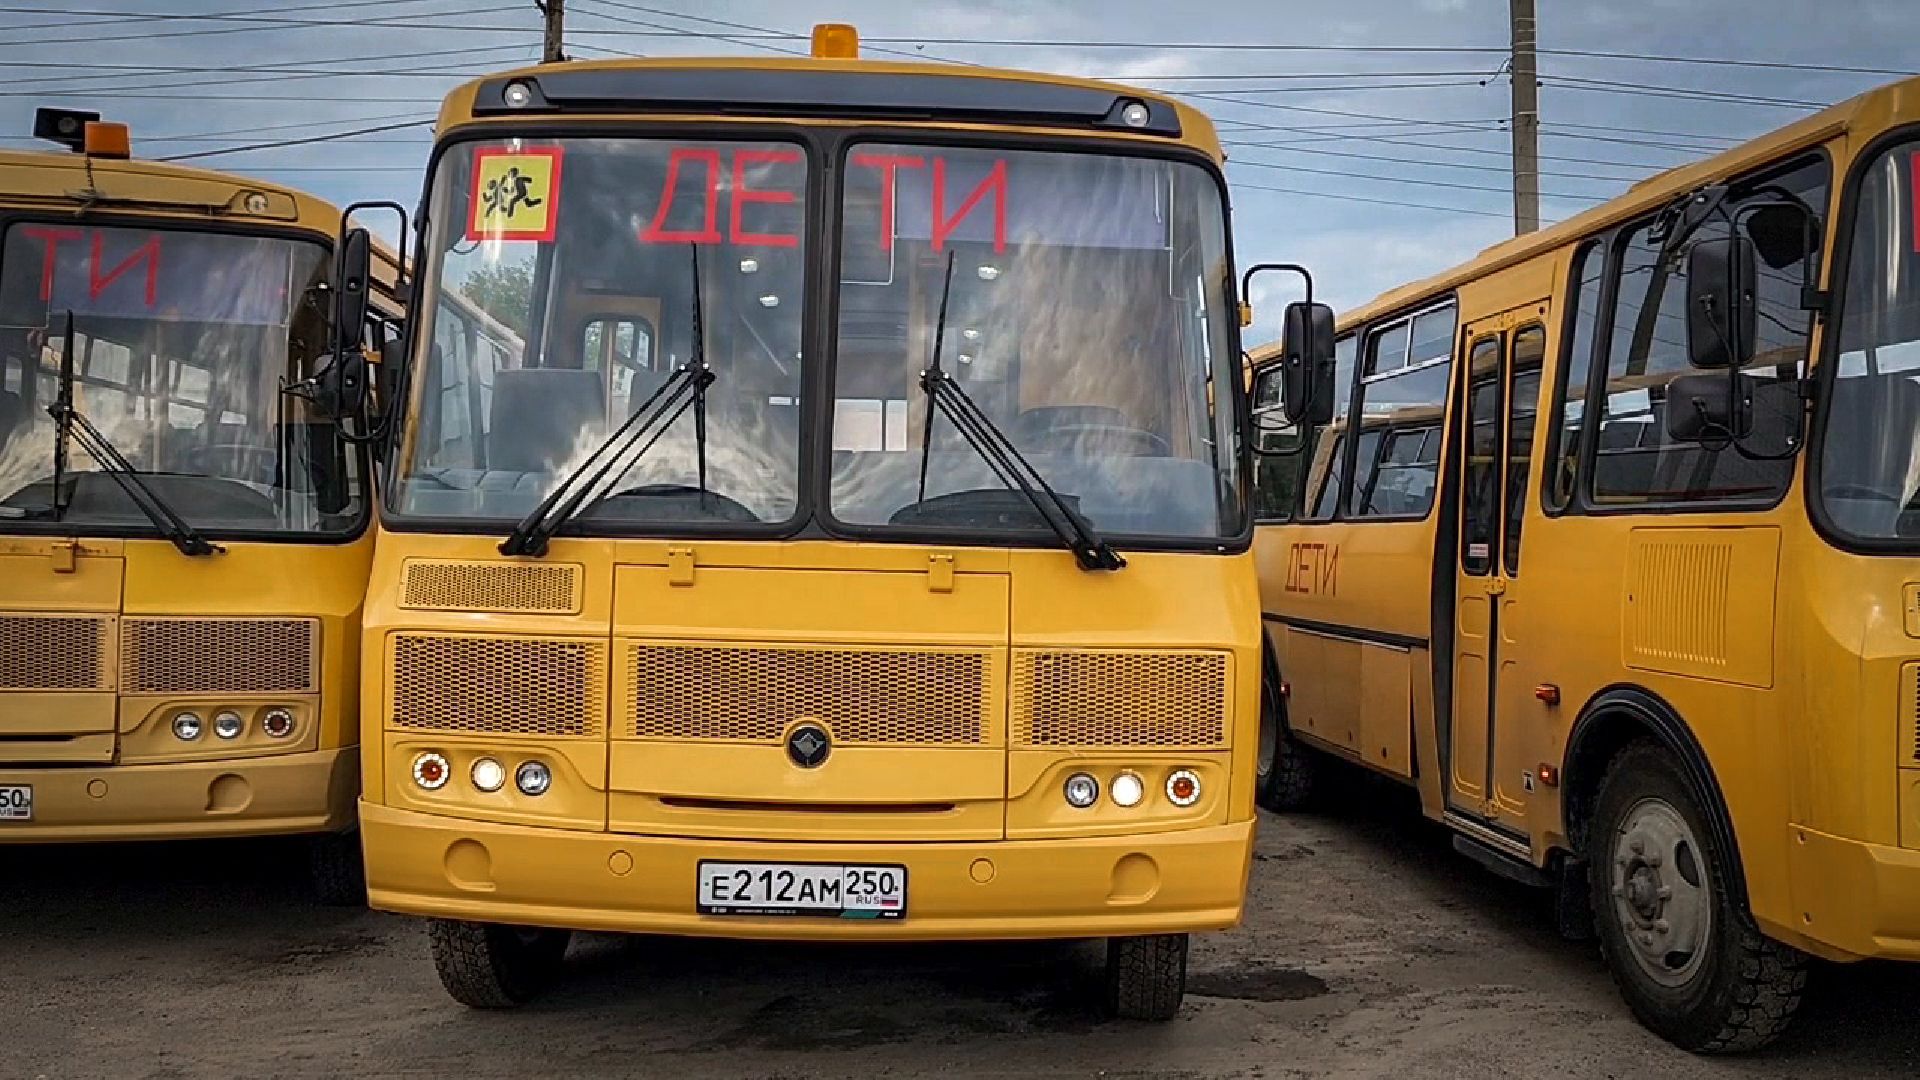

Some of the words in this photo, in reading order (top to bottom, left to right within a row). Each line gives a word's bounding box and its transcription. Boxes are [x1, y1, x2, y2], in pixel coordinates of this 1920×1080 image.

[23, 226, 161, 309] ТИ
[1285, 543, 1339, 597] ДЕТИ
[712, 869, 842, 904] Е212АМ
[846, 870, 894, 896] 250
[856, 896, 880, 905] RUS
